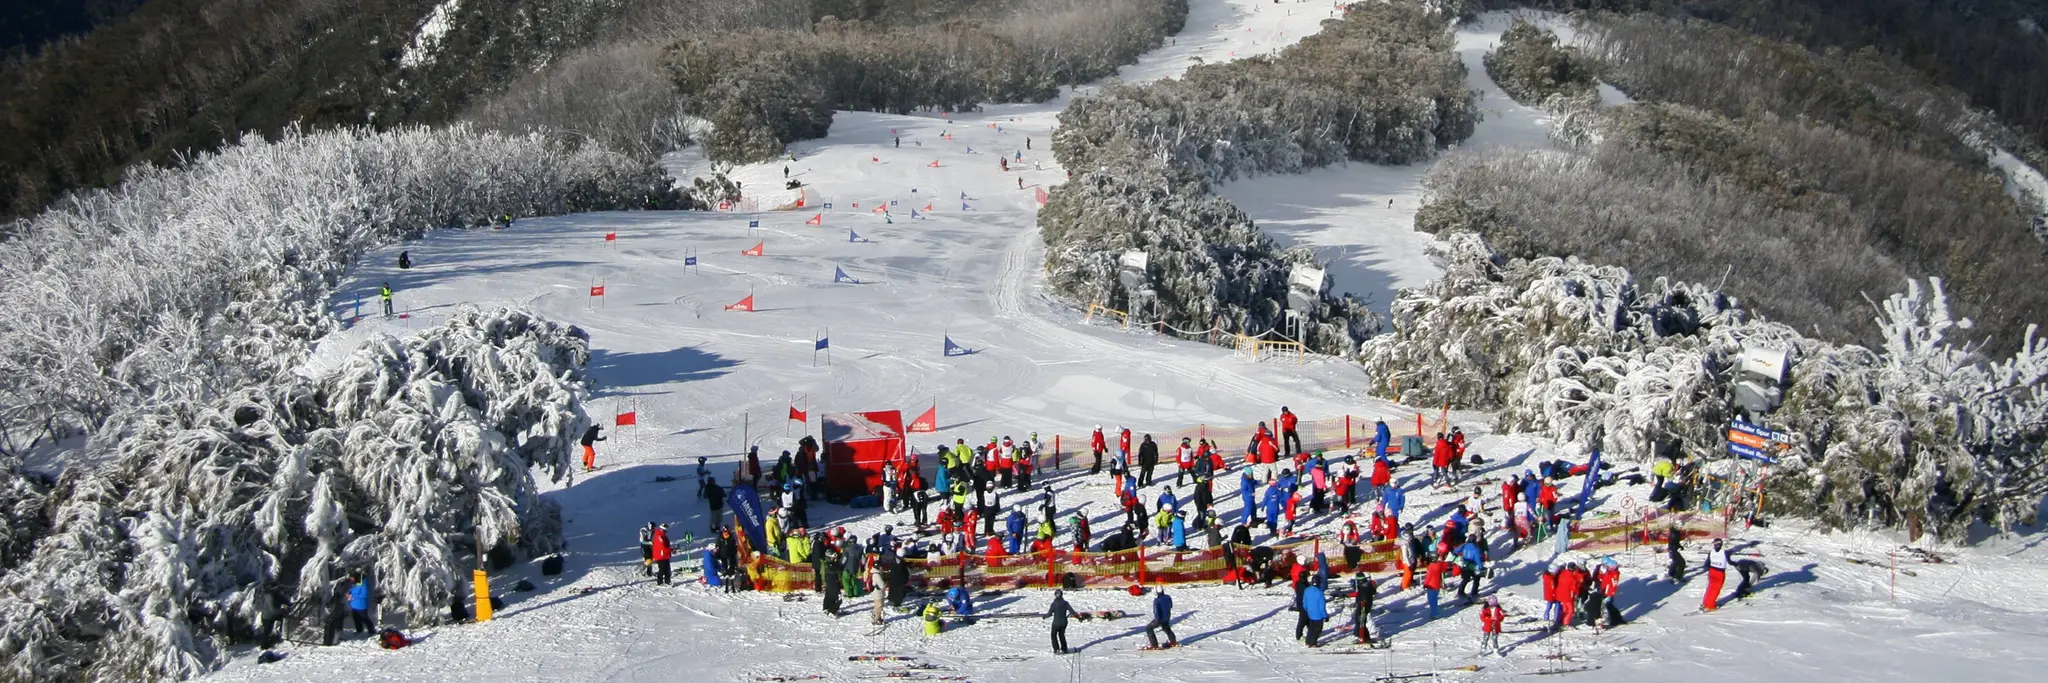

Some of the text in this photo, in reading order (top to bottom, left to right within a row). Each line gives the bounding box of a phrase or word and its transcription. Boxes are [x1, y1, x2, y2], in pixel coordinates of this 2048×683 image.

[1739, 423, 1755, 433] Buller
[1756, 428, 1770, 437] Spur
[1731, 444, 1755, 456] Wombat
